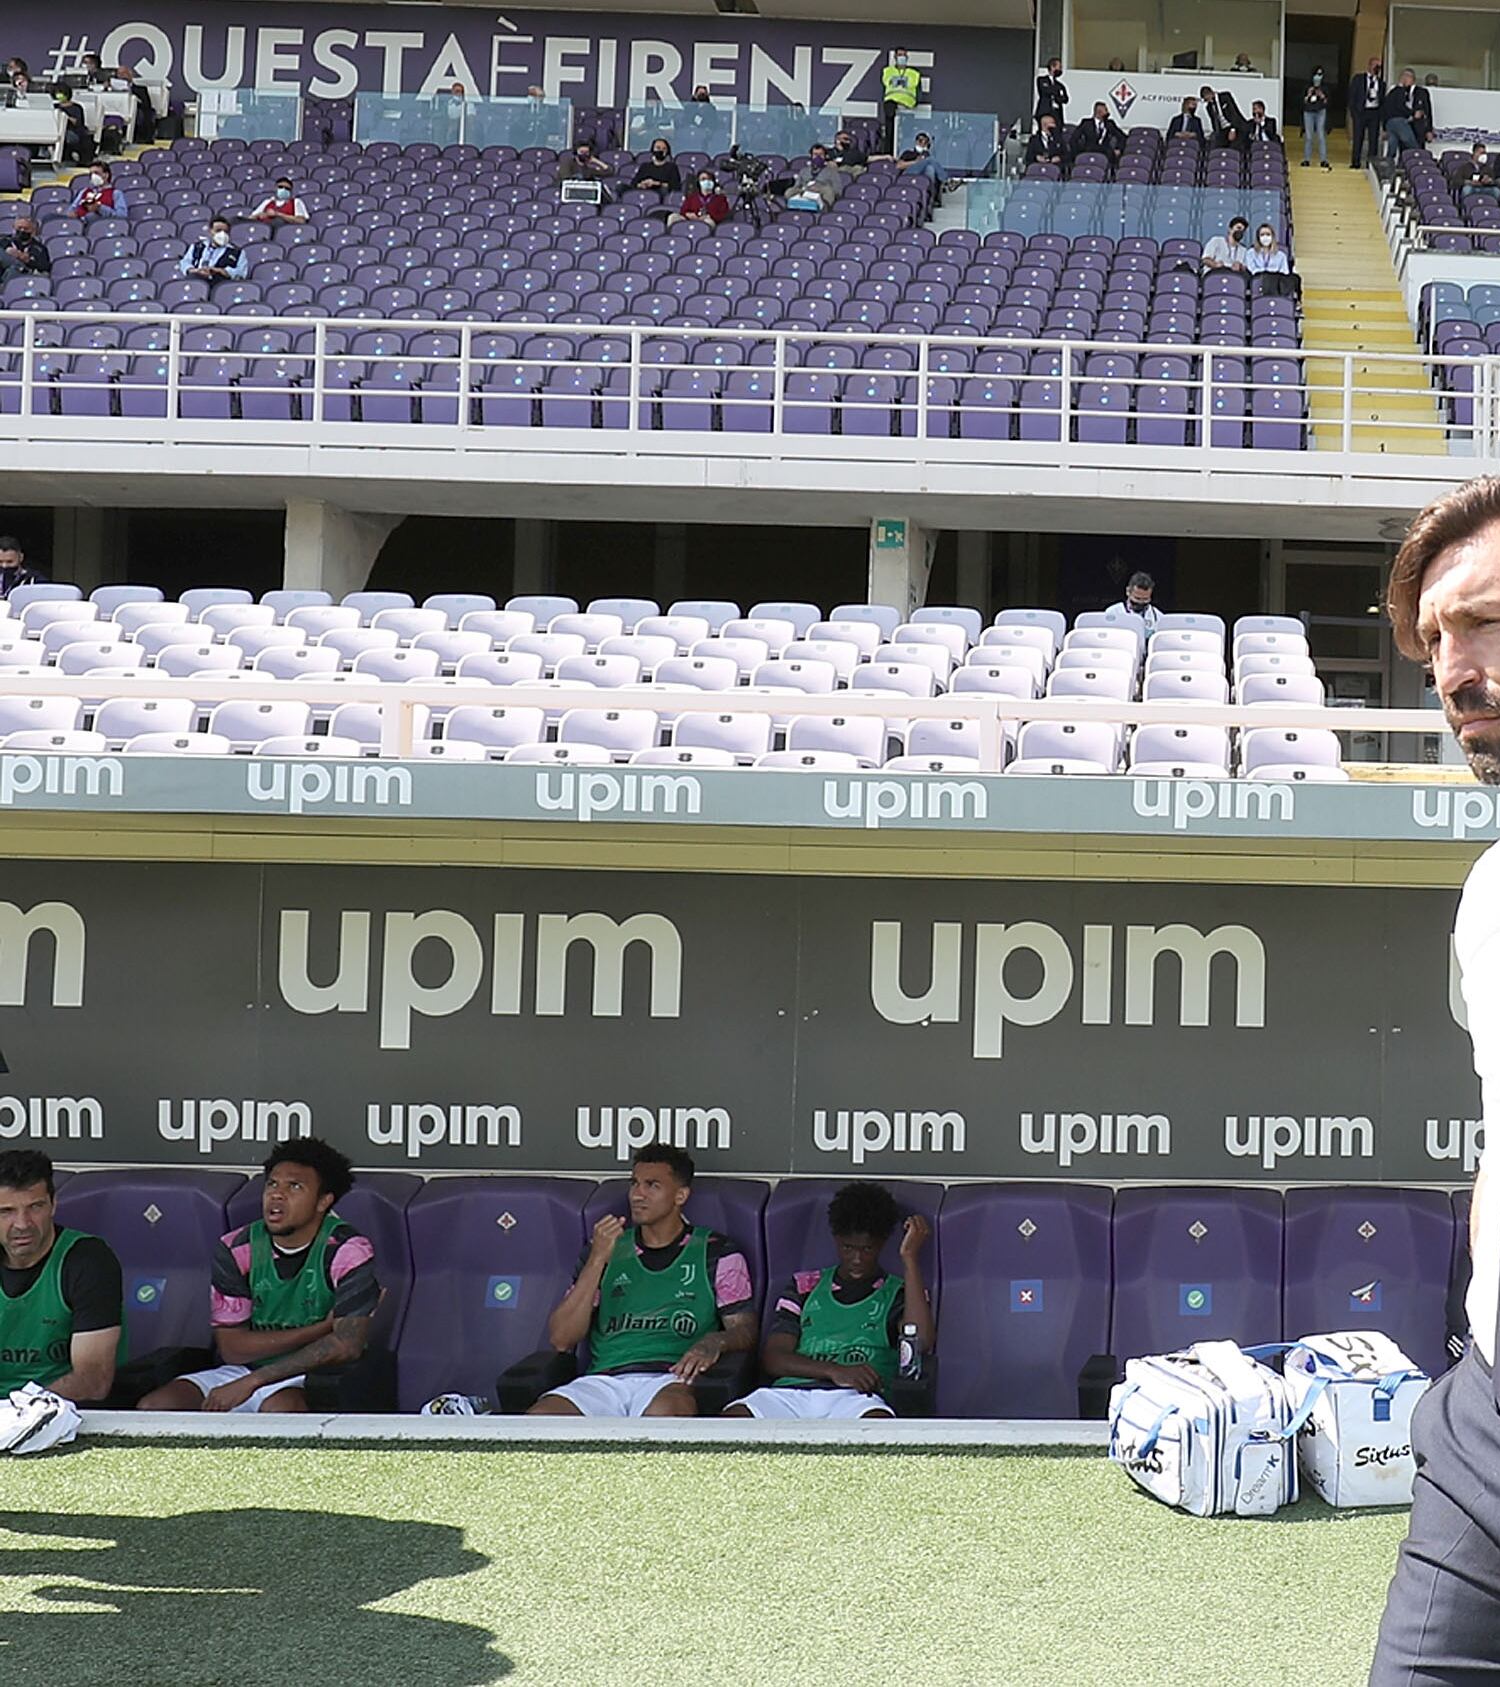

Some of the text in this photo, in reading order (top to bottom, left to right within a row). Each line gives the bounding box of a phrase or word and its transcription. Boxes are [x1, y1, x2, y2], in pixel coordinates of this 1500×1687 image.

[1, 755, 123, 804] pim
[248, 763, 411, 812] upim
[537, 772, 700, 822] upim
[824, 780, 986, 829] upim
[1133, 781, 1294, 829] upim
[279, 910, 681, 1049] upim
[872, 922, 1265, 1058] upim
[0, 1096, 103, 1138] pim
[159, 1100, 311, 1152] upim
[368, 1105, 520, 1157] upim
[578, 1107, 730, 1160] upim
[814, 1111, 965, 1163] upim
[1021, 1114, 1170, 1166] upim
[1226, 1117, 1373, 1168] upim
[1426, 1119, 1485, 1172] up
[1354, 1444, 1411, 1467] Sixtus
